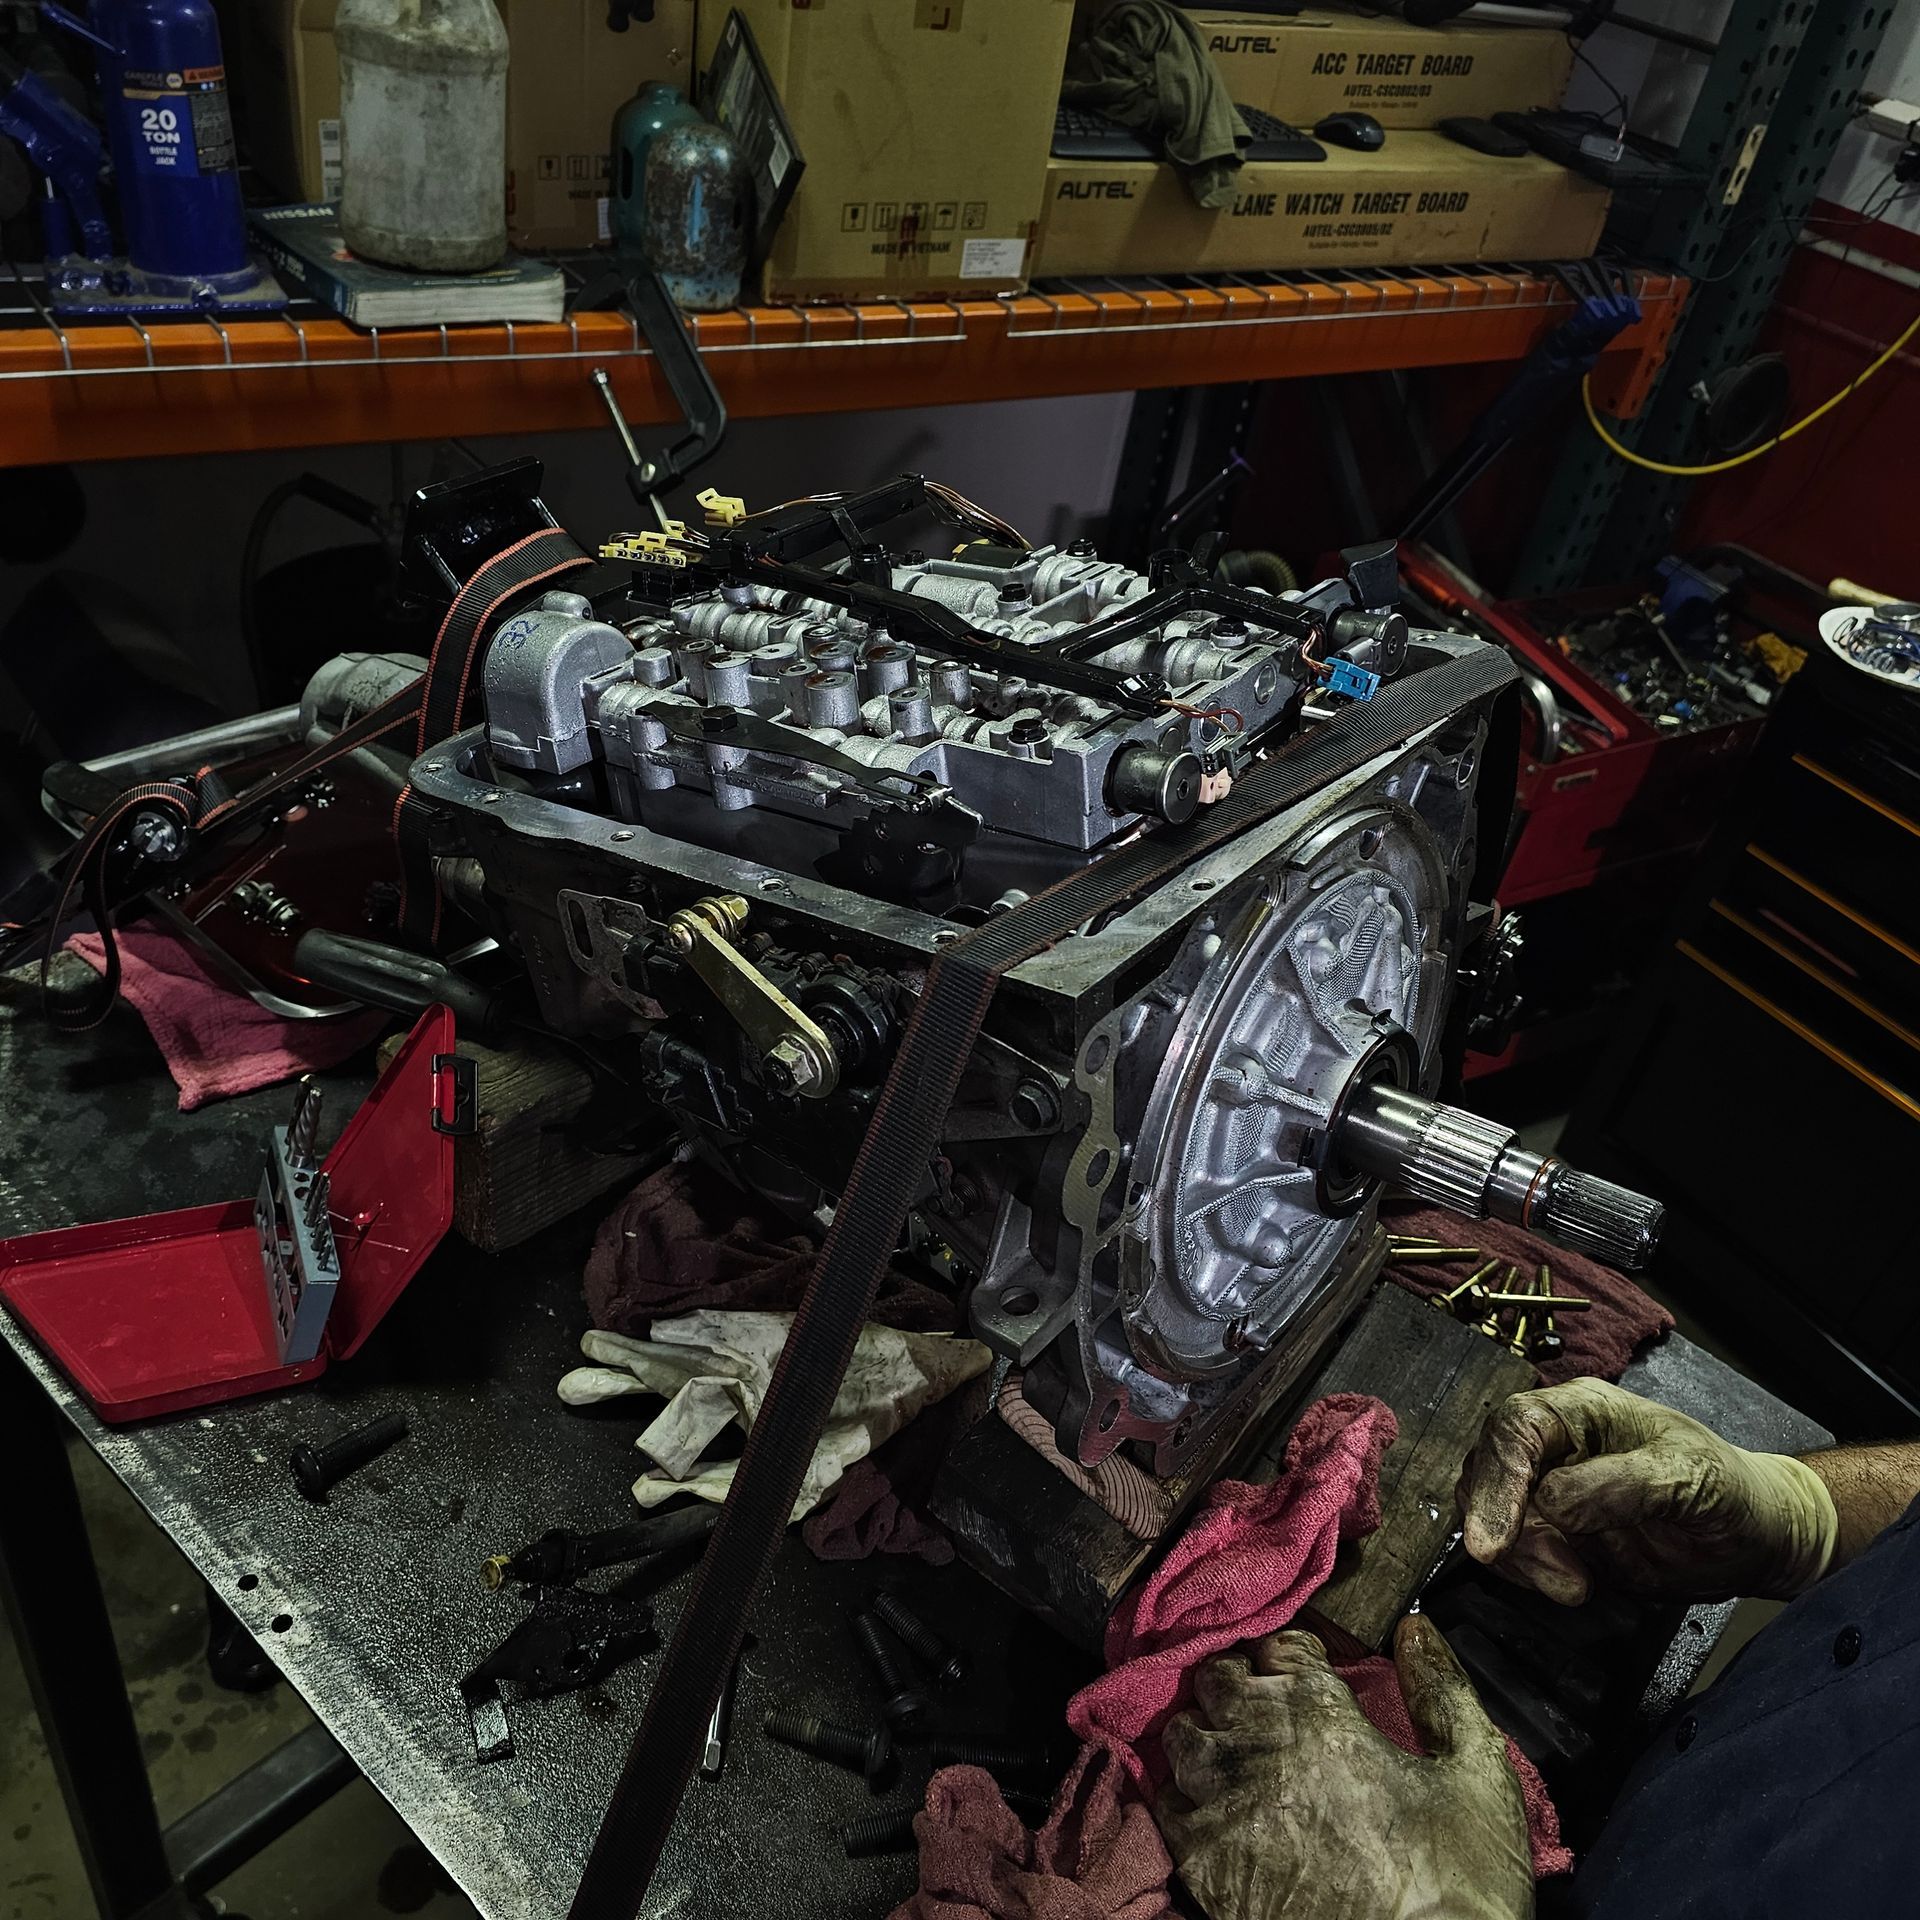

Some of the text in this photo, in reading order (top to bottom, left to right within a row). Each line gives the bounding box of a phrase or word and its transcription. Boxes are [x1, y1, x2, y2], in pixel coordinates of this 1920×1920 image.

[1208, 35, 1278, 54] AUTEL
[1311, 53, 1474, 76] ACC TARGET BOARD
[141, 108, 177, 131] 20
[141, 131, 181, 144] TON
[1057, 181, 1135, 200] AUTEL
[1232, 191, 1470, 216] LANE WATCH TARGET BOARD
